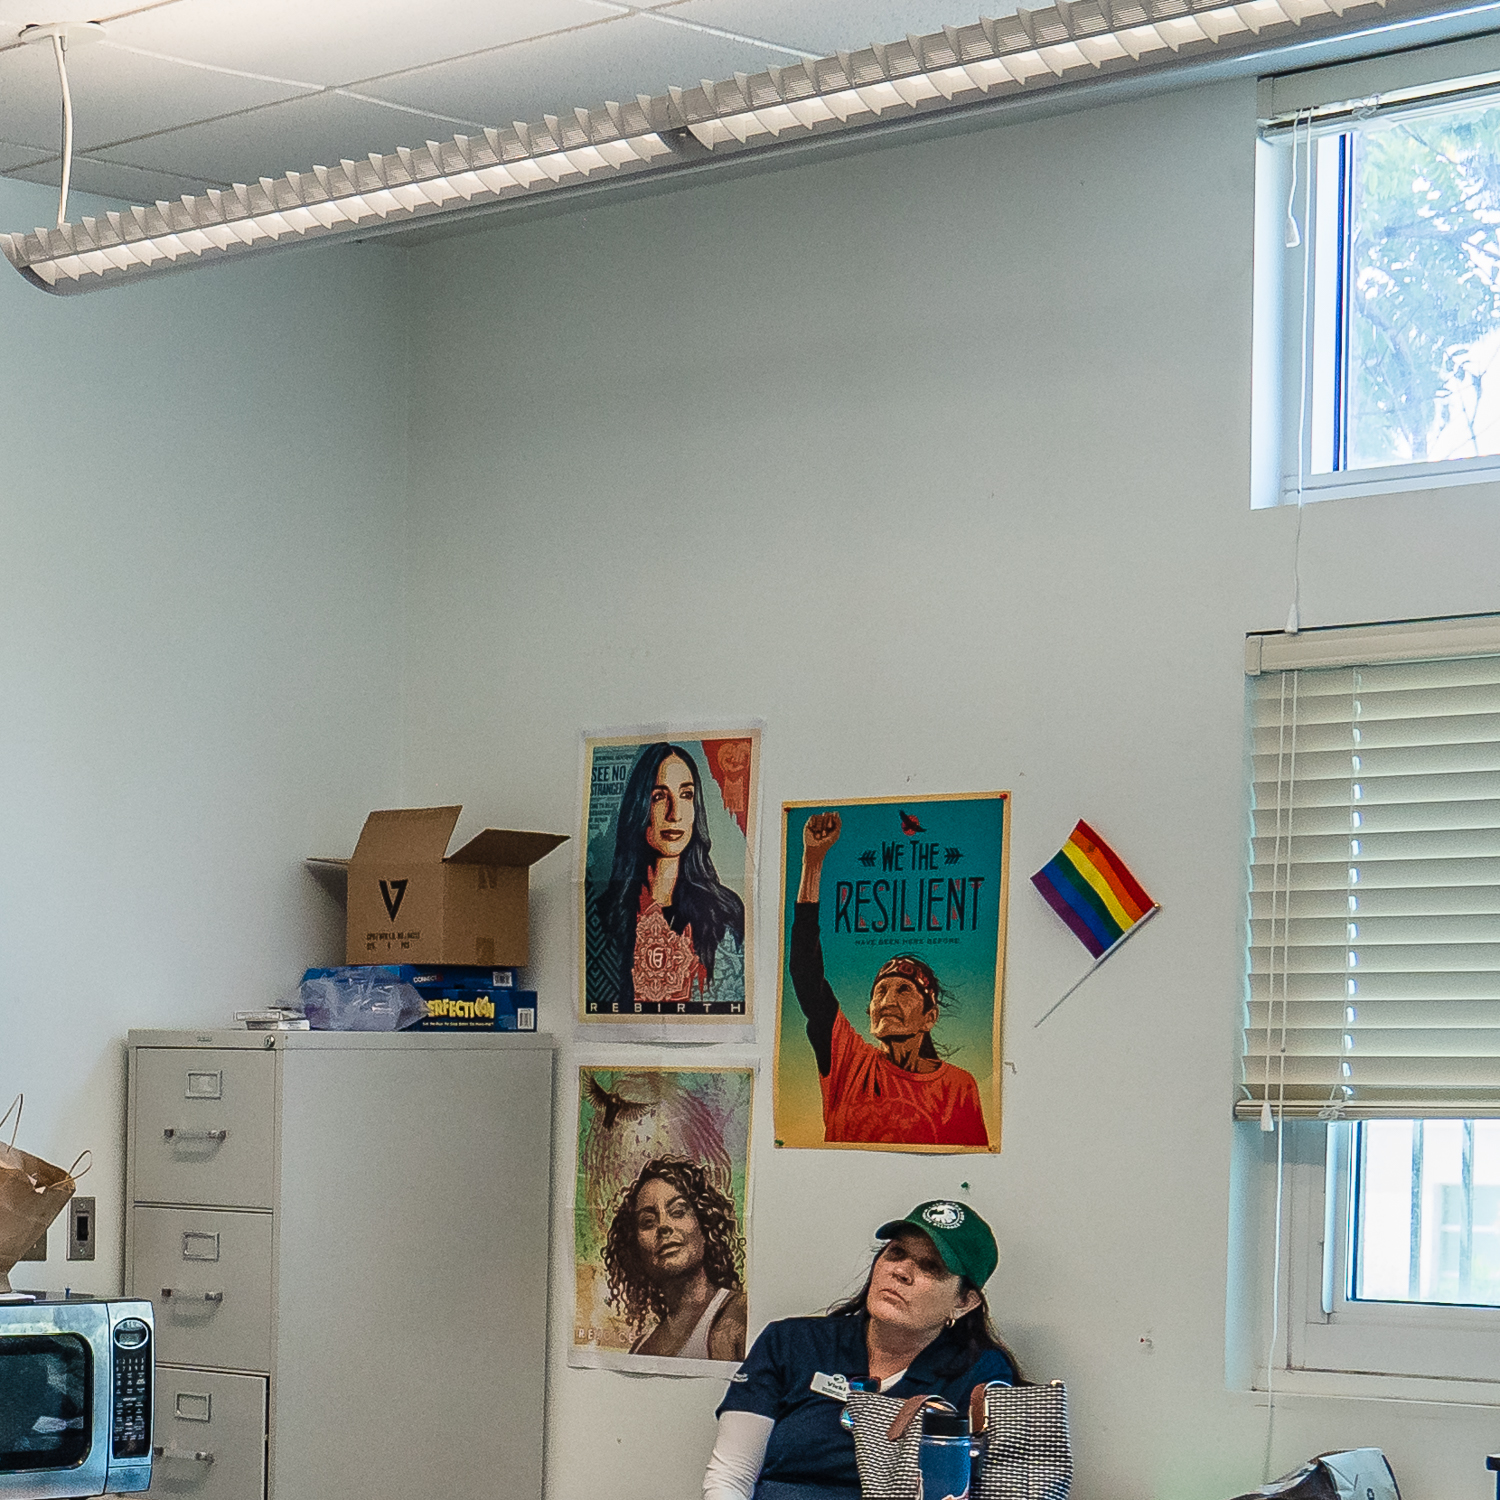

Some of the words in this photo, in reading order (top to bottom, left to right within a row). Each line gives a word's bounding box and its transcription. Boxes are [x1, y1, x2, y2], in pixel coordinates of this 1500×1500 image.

[591, 767, 610, 781] SEE
[612, 765, 626, 781] NO
[882, 841, 904, 872] WE
[910, 840, 939, 871] THE
[835, 877, 985, 933] RESILIENT
[427, 996, 495, 1019] ERFECTION
[590, 1002, 741, 1013] REBIRTH
